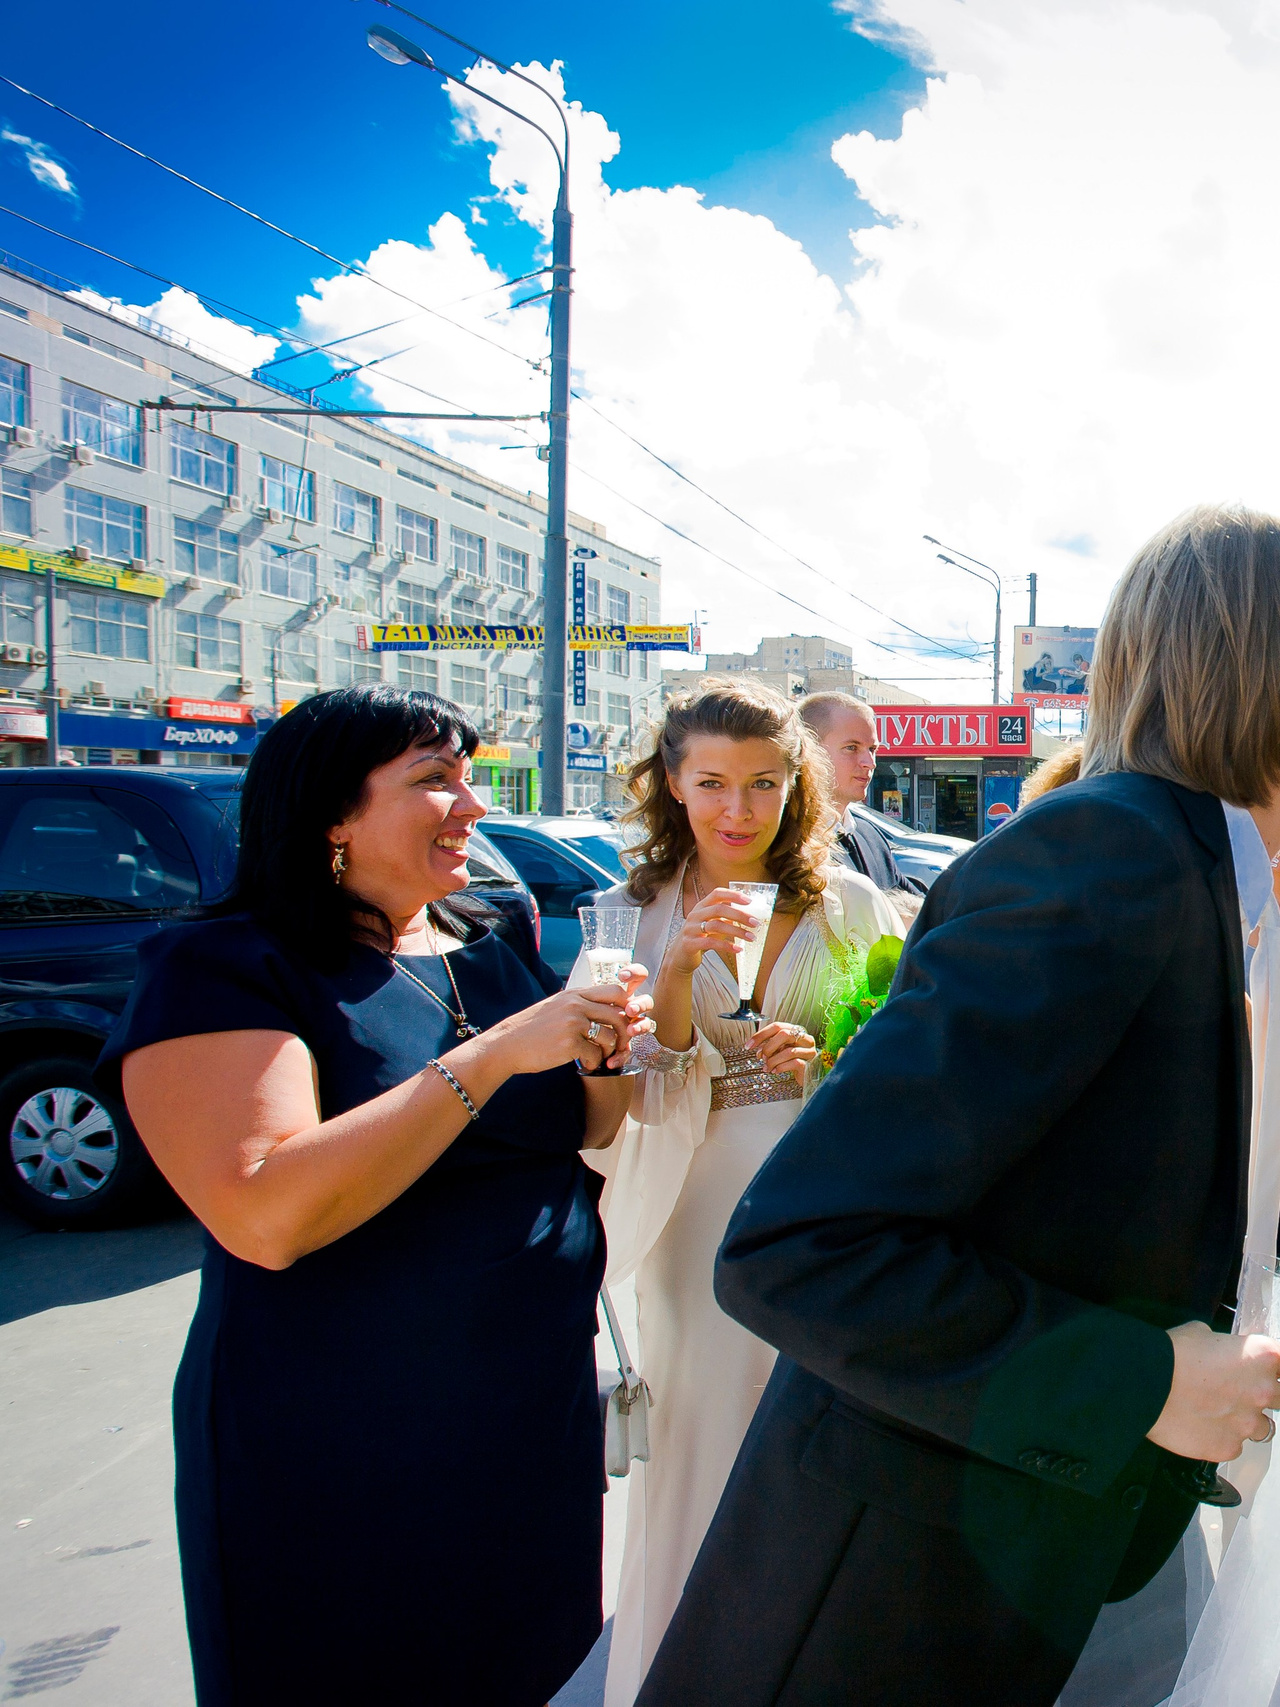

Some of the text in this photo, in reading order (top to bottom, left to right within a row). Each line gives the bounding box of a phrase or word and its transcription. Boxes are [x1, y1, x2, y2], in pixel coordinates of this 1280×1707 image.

[434, 625, 493, 641] МЕХА
[494, 629, 517, 641] на
[432, 642, 495, 650] ВЫСТАВКА
[180, 701, 242, 719] ДИВАНЫ
[873, 714, 989, 750] ДУКТЫ
[1001, 717, 1023, 734] 24
[1001, 734, 1023, 742] часа
